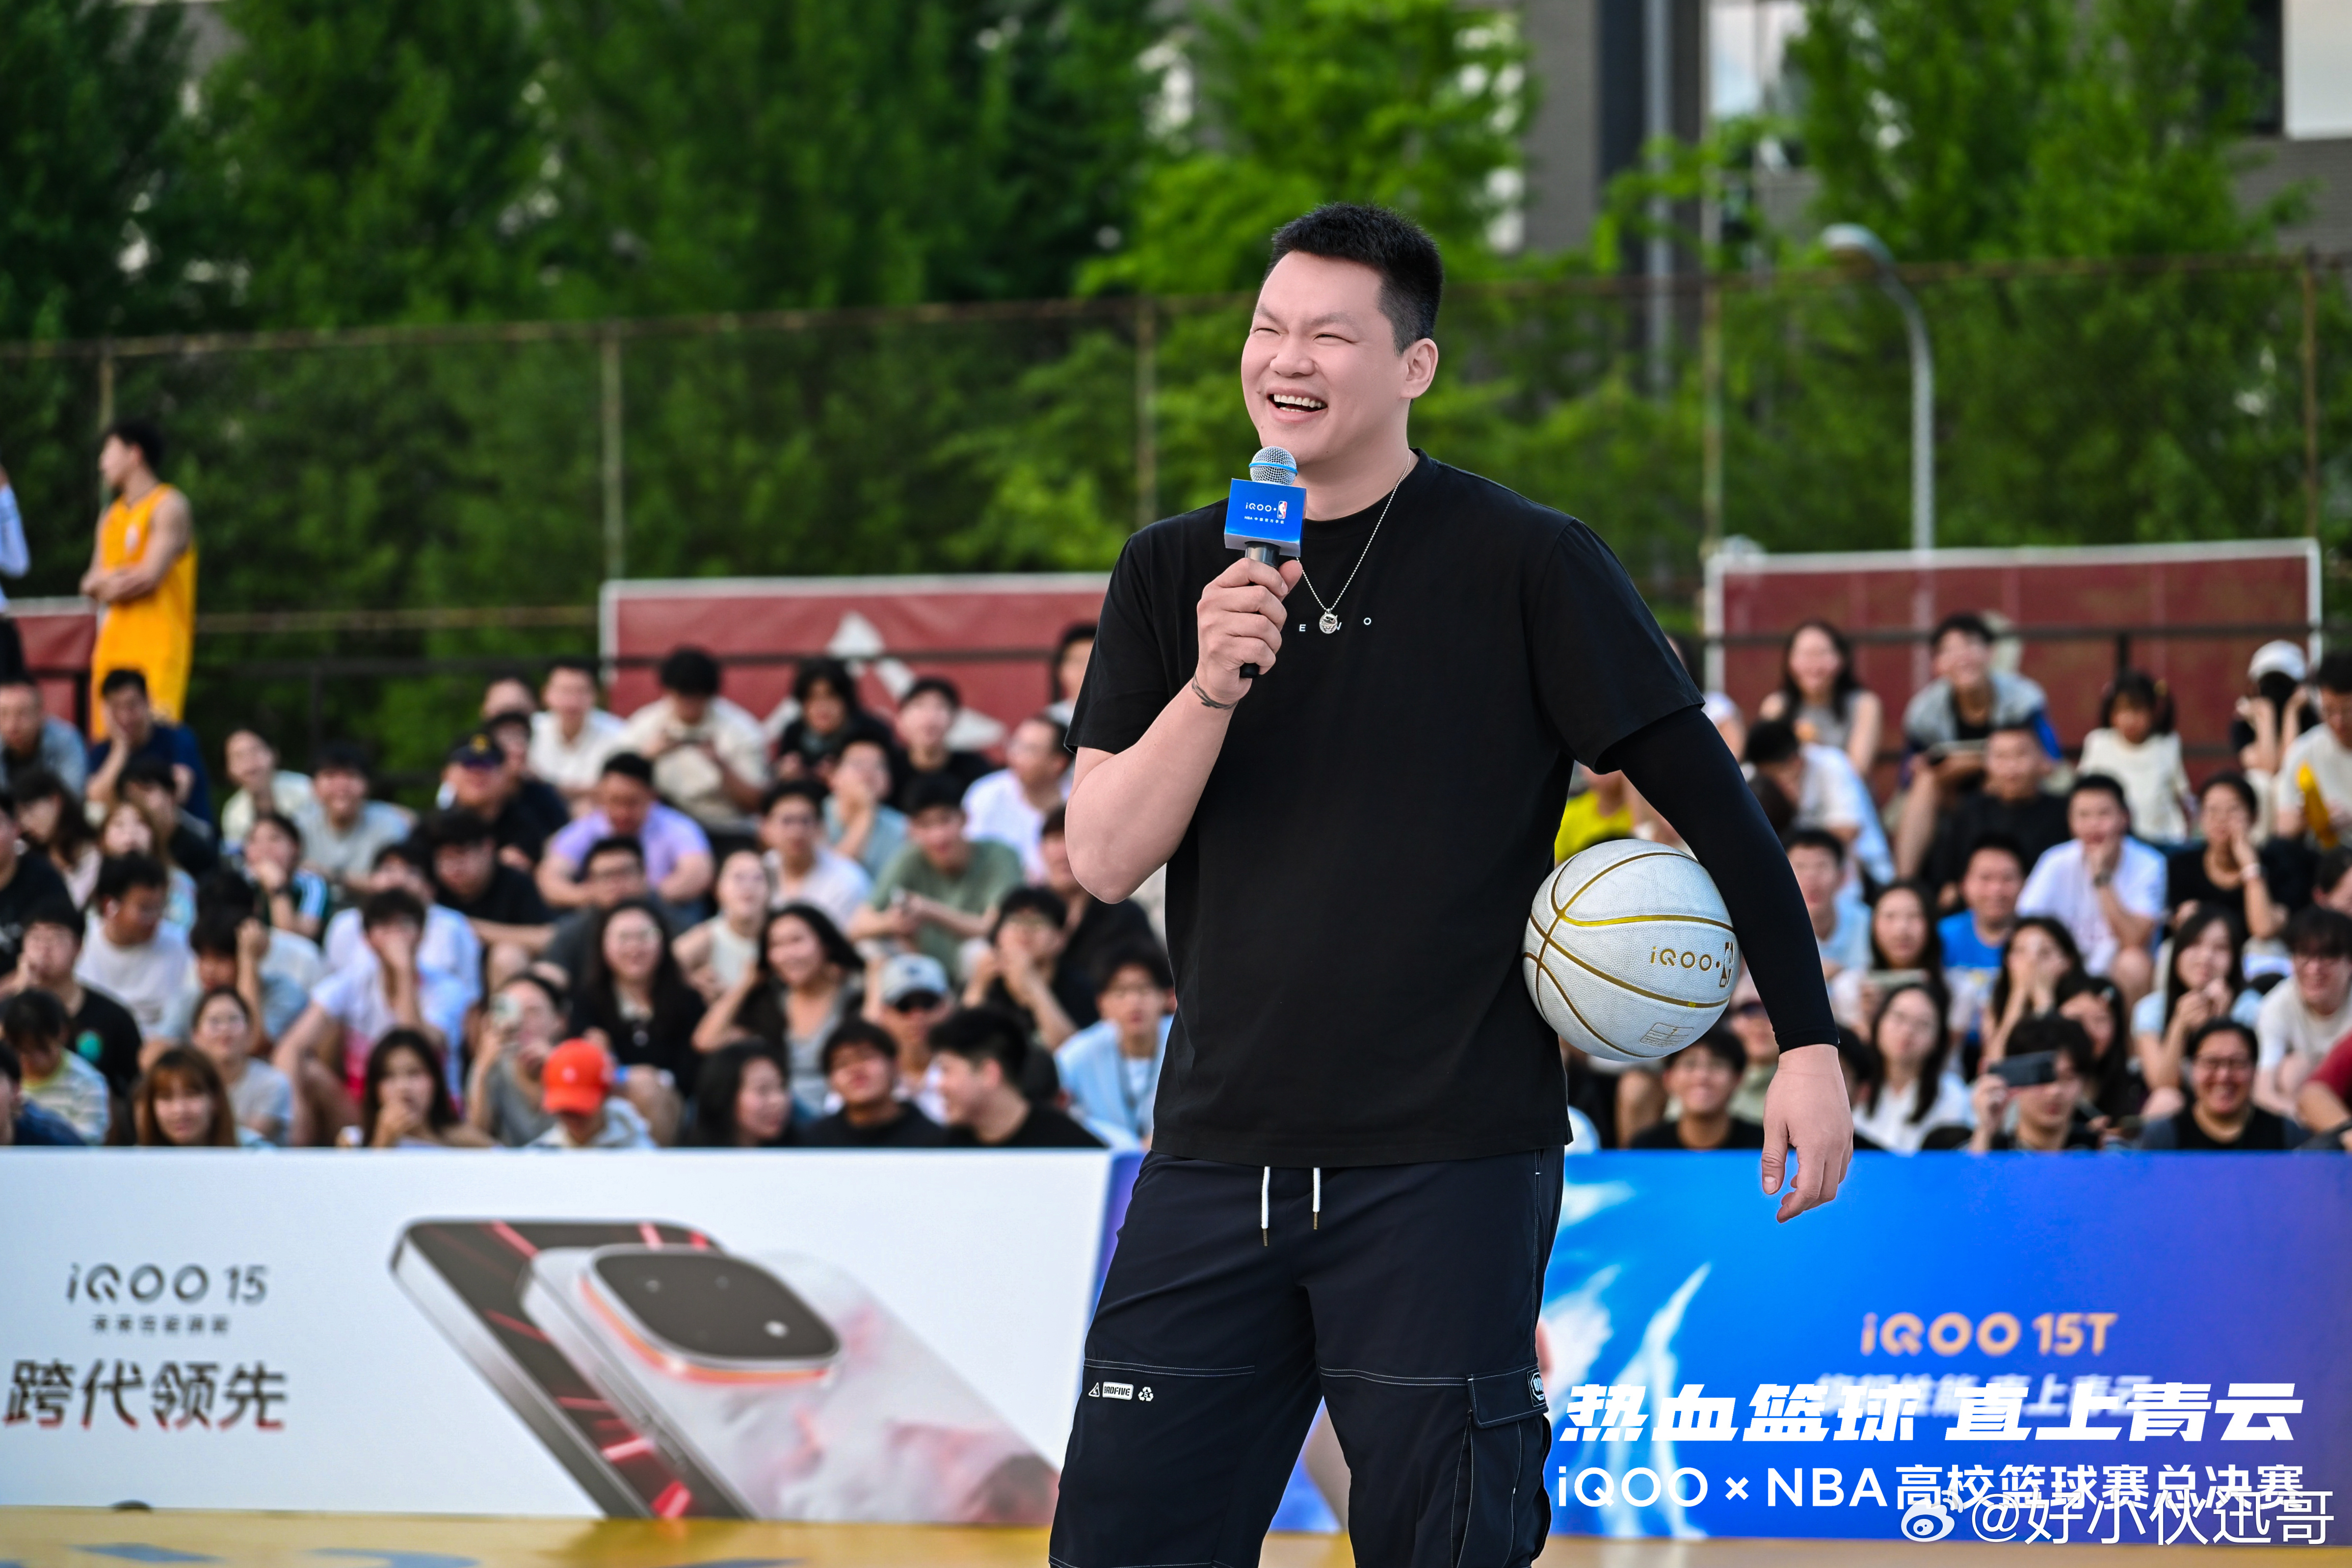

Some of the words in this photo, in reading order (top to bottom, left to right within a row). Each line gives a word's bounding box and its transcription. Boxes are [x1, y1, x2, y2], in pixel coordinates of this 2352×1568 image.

[1245, 502, 1272, 512] iQOO
[1650, 946, 1713, 972] iQOO
[66, 1262, 210, 1304] iQOO
[225, 1264, 269, 1304] 15
[1860, 1312, 2021, 1356] iQOO
[2032, 1312, 2117, 1356] 15T
[3, 1357, 289, 1430] 跨代领先
[1104, 1386, 1131, 1396] BADFIVE
